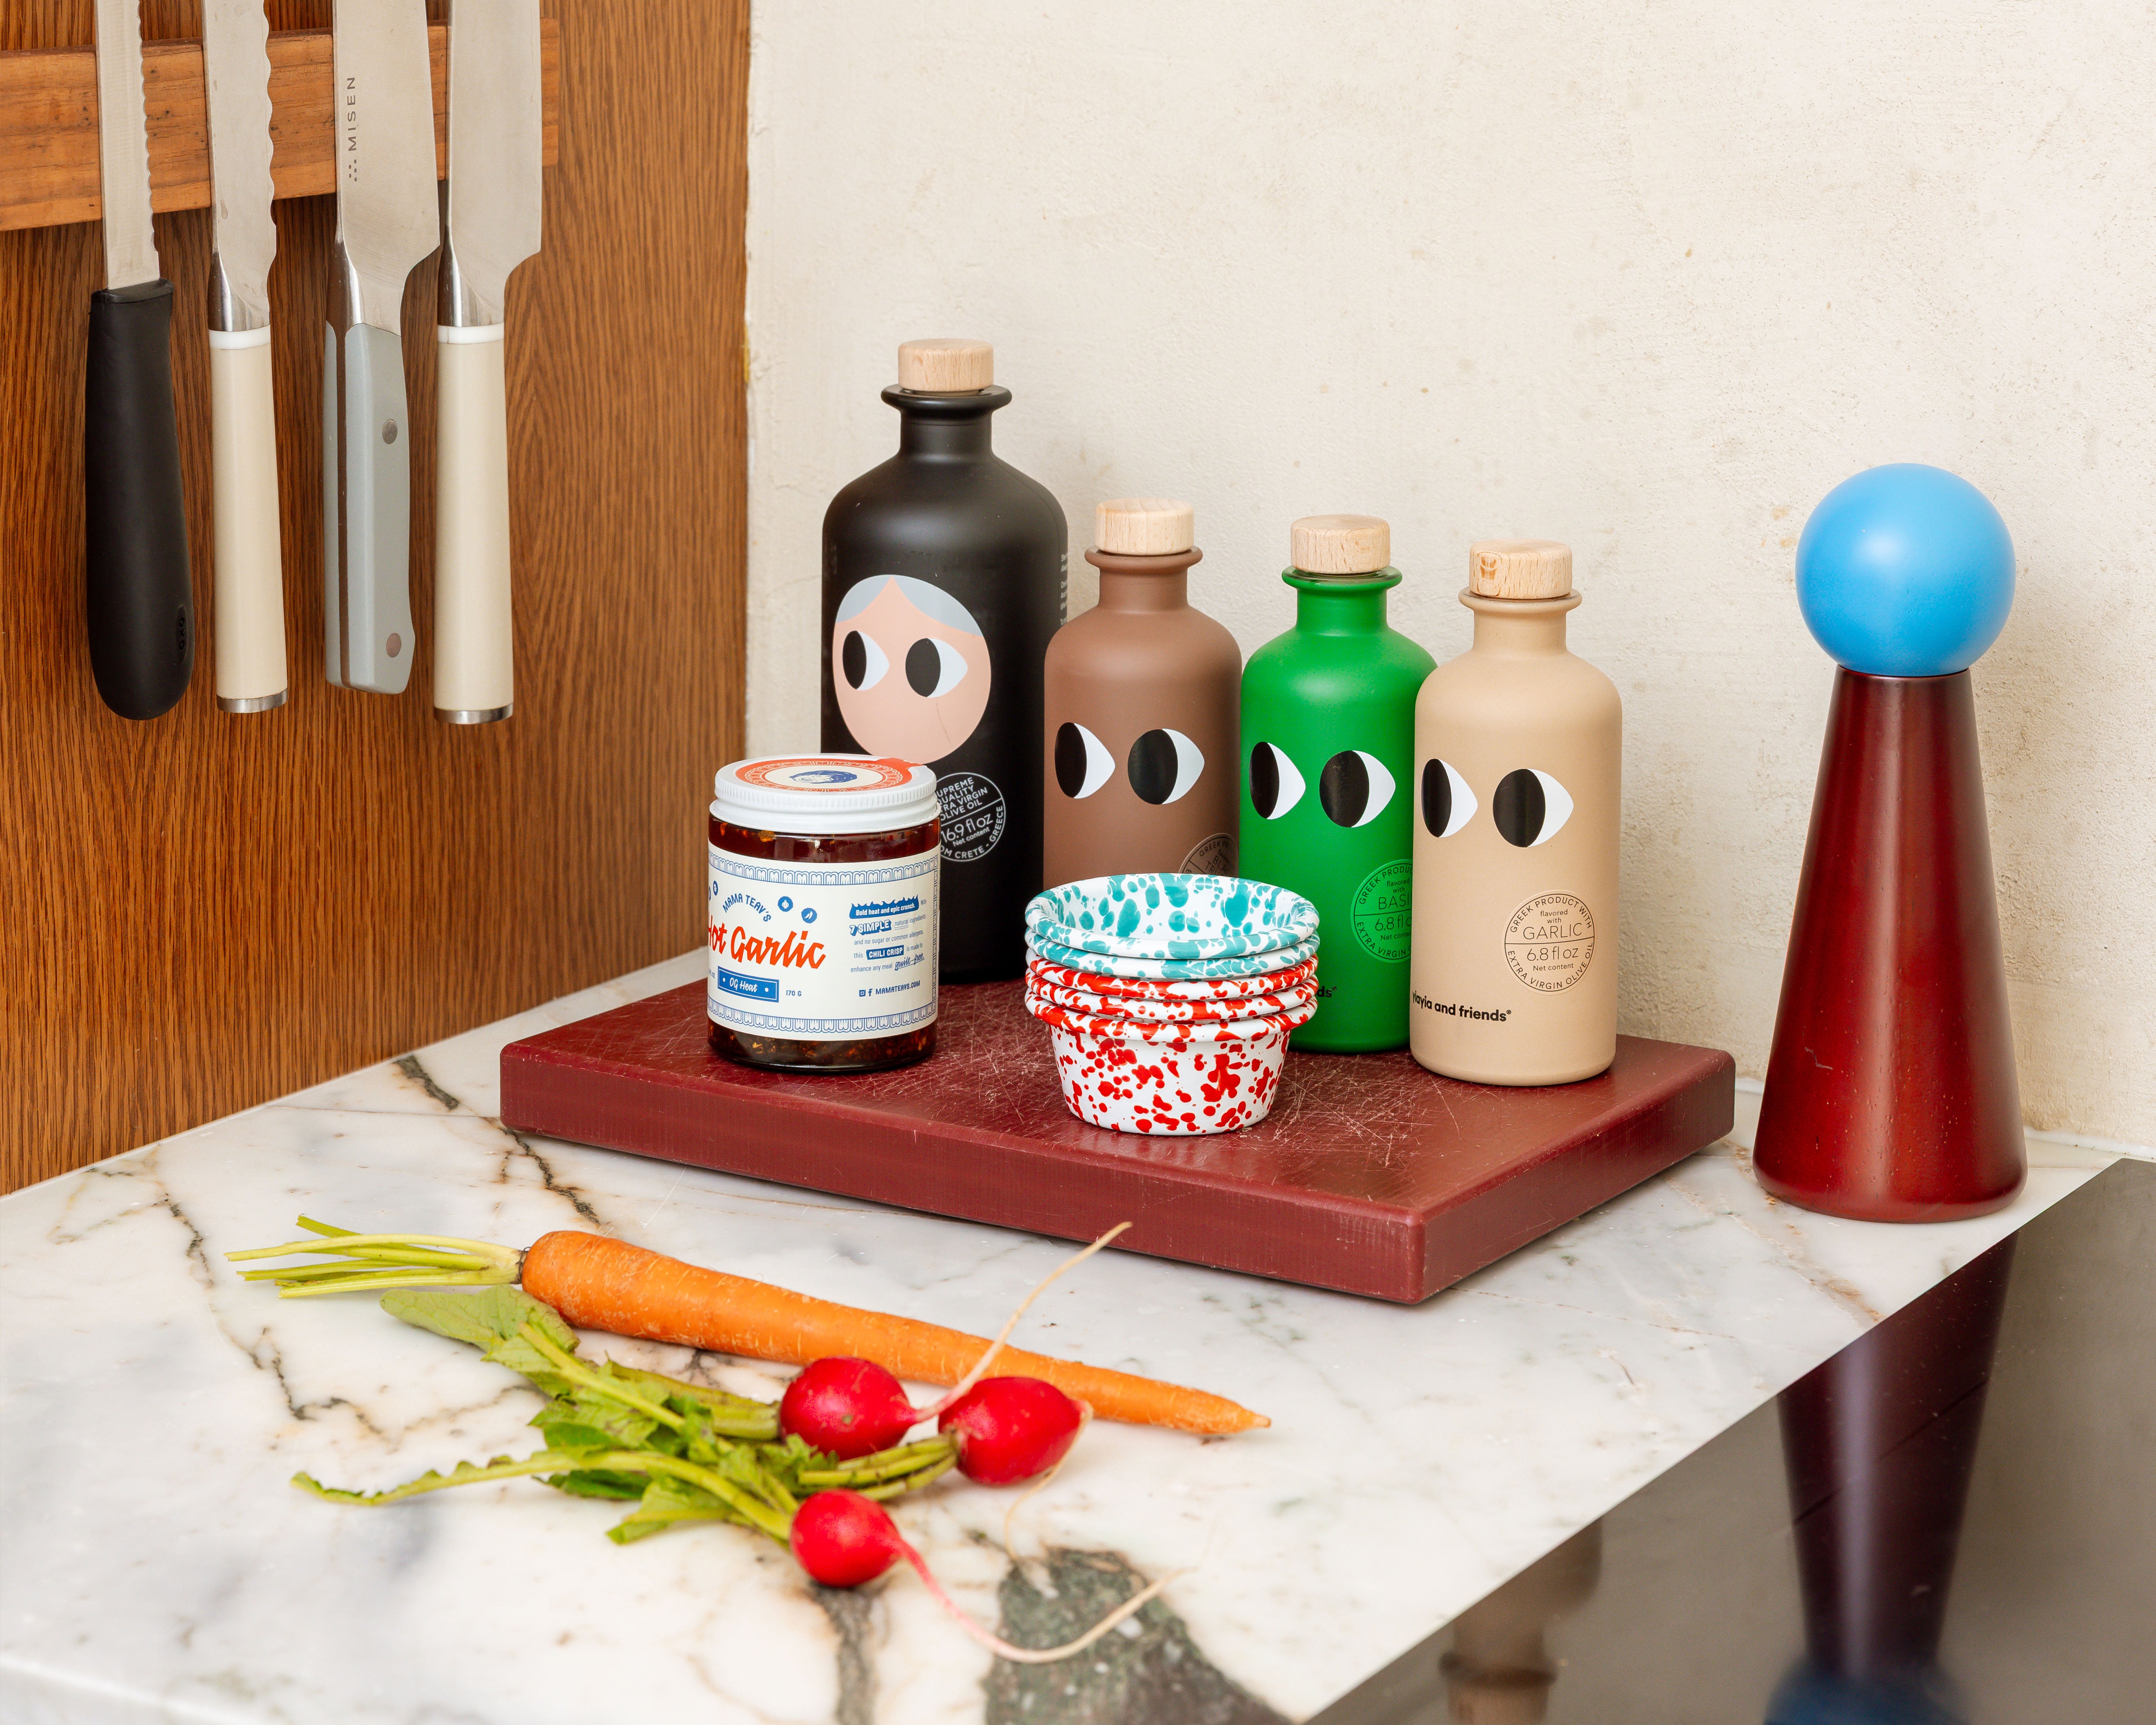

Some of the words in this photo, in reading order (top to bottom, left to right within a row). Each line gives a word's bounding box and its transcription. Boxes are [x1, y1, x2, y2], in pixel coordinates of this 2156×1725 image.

[347, 77, 356, 151] MISEN
[937, 777, 974, 797] UPREME
[957, 787, 988, 805] VIRGIN
[940, 805, 966, 821] OLIVE
[967, 799, 983, 811] OIL
[941, 824, 965, 843] 16.9
[966, 818, 975, 832] fl
[941, 845, 952, 856] OM
[955, 845, 984, 859] CRETE
[989, 805, 1003, 842] GREECE
[953, 837, 965, 847] Net
[966, 827, 990, 842] content
[1359, 876, 1381, 904] GREEK
[1387, 878, 1410, 887] flavored
[722, 893, 743, 913] MAMA
[745, 894, 771, 922] TEAV'S
[890, 905, 900, 913] epic
[1510, 905, 1534, 932] GREEK
[1535, 896, 1579, 908] PRODUCT
[1579, 906, 1592, 929] WITH
[849, 925, 858, 936] 7
[909, 914, 926, 924] ingredients
[1375, 917, 1394, 931] 6.8
[1397, 914, 1403, 929] fl
[1523, 923, 1582, 940] GARLIC
[730, 926, 826, 969] Garlic
[1357, 922, 1375, 950] EXTRA
[1378, 946, 1406, 958] VIRGIN
[869, 949, 885, 958] CHILI
[886, 947, 903, 956] CRISP
[1527, 948, 1548, 961] 6.8
[1552, 946, 1559, 960] fl
[1508, 951, 1528, 980] EXTRA
[1530, 977, 1562, 989] VIRGIN
[1566, 961, 1587, 984] OLIVE
[729, 977, 739, 989] OG
[739, 981, 758, 993] Heat
[875, 980, 920, 994] MAMATEAVS.COM
[1412, 990, 1433, 1010] yiayia
[1434, 1003, 1456, 1016] and
